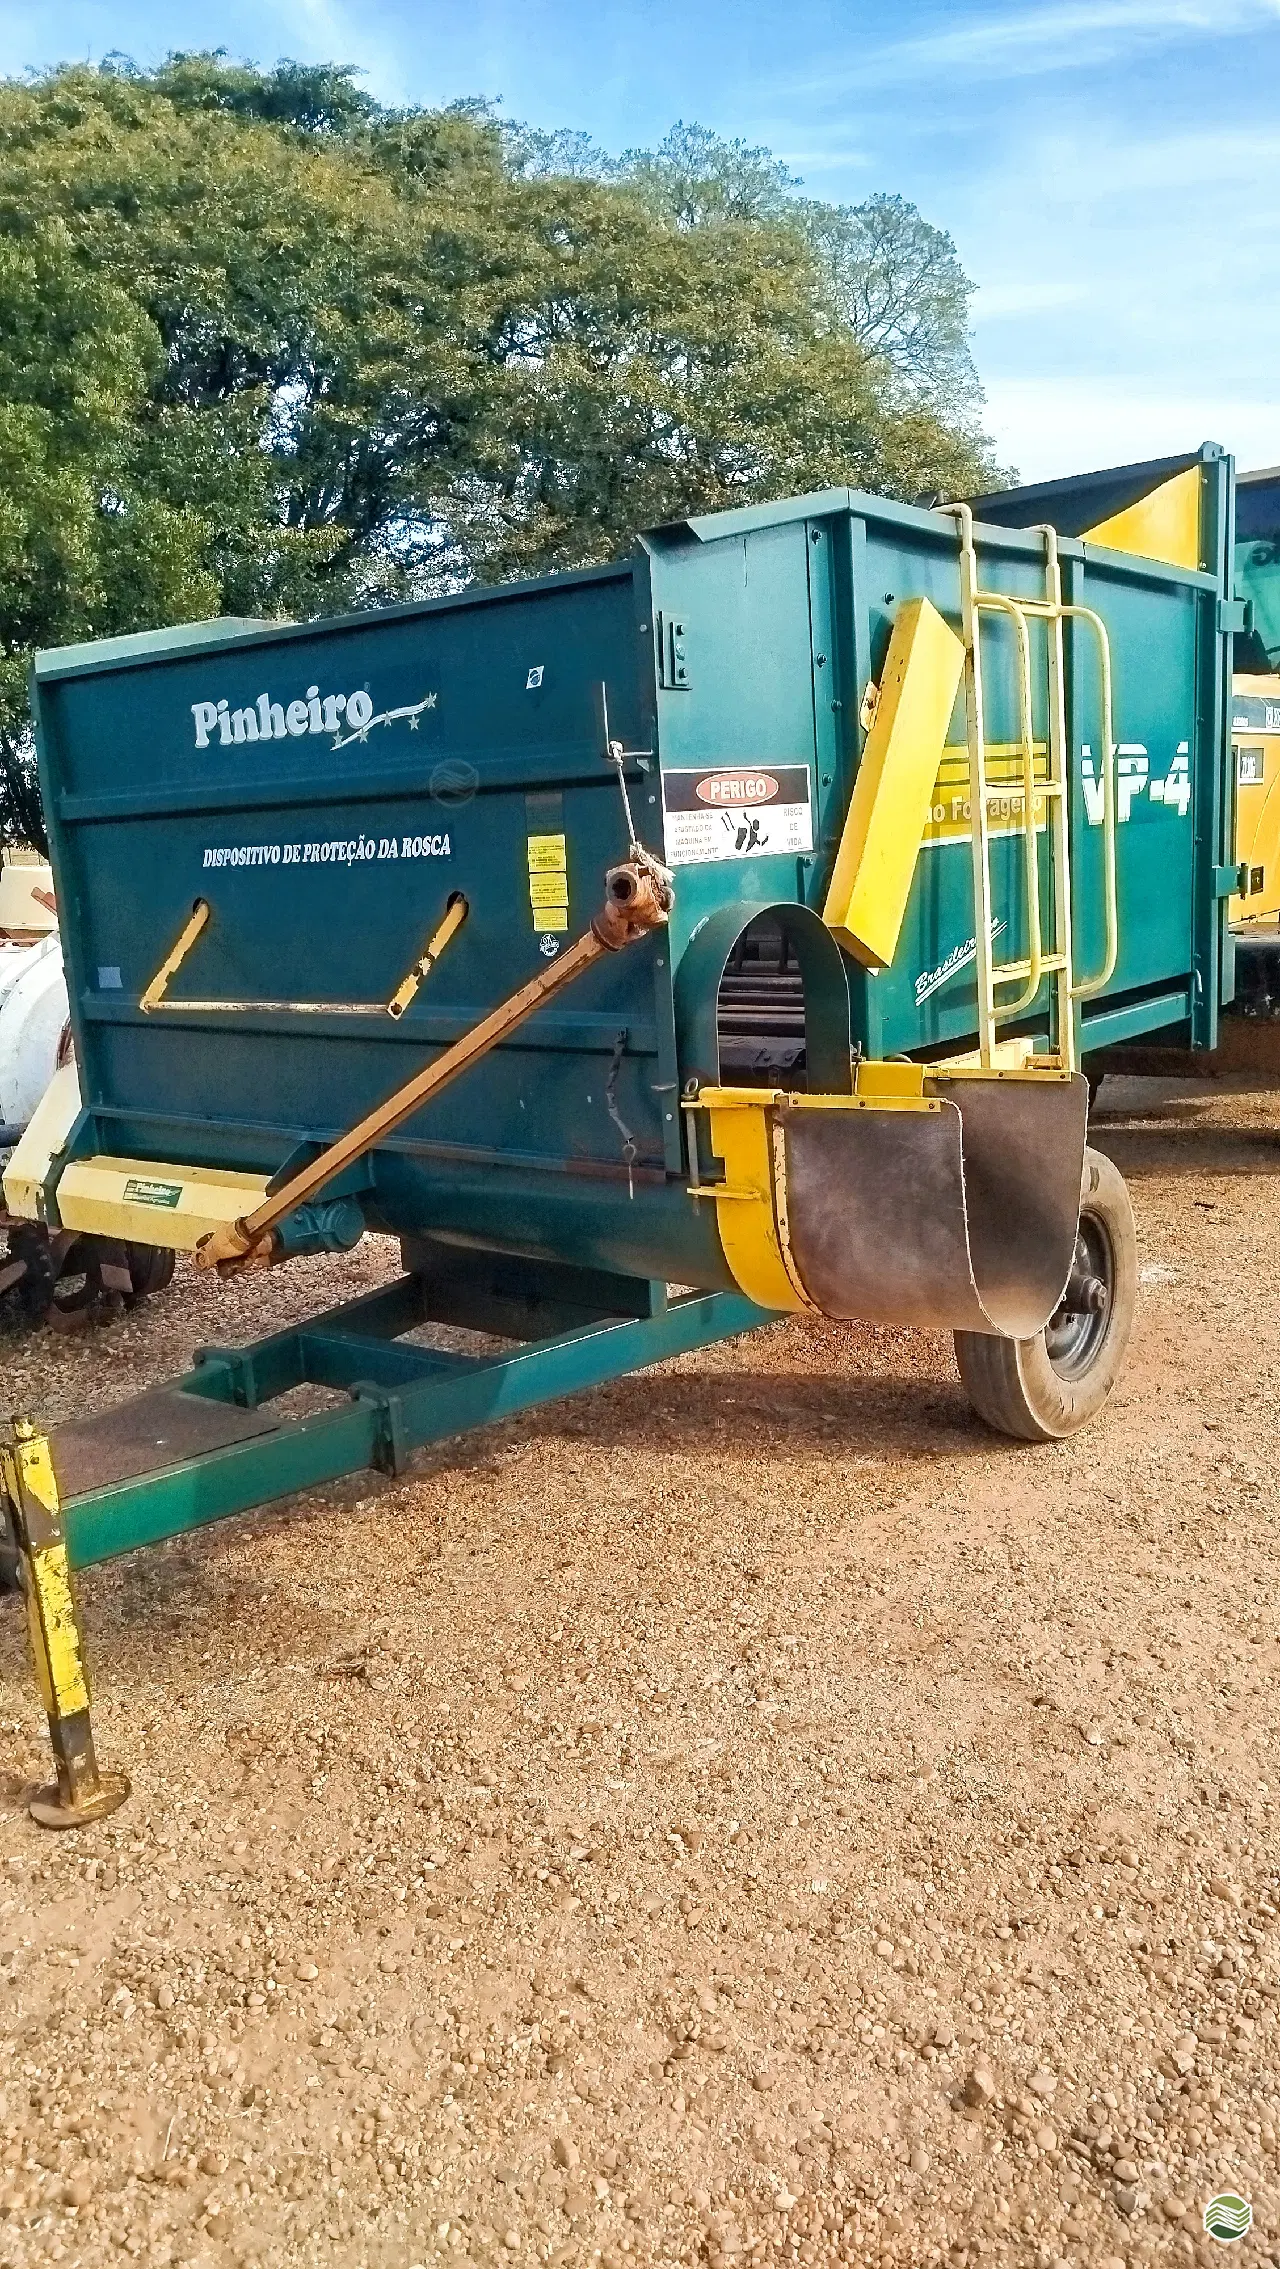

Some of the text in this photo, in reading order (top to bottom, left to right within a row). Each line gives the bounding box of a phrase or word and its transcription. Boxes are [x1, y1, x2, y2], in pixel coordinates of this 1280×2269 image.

[191, 685, 373, 748] Pinheiro
[710, 778, 767, 800] PERIGO
[1081, 741, 1191, 825] VP-4
[783, 806, 803, 817] RISCO
[789, 823, 799, 832] DE
[203, 833, 451, 868] DISPOSITIVO DE PROTEÇÃO DA ROSCA
[786, 837, 802, 846] VIDA
